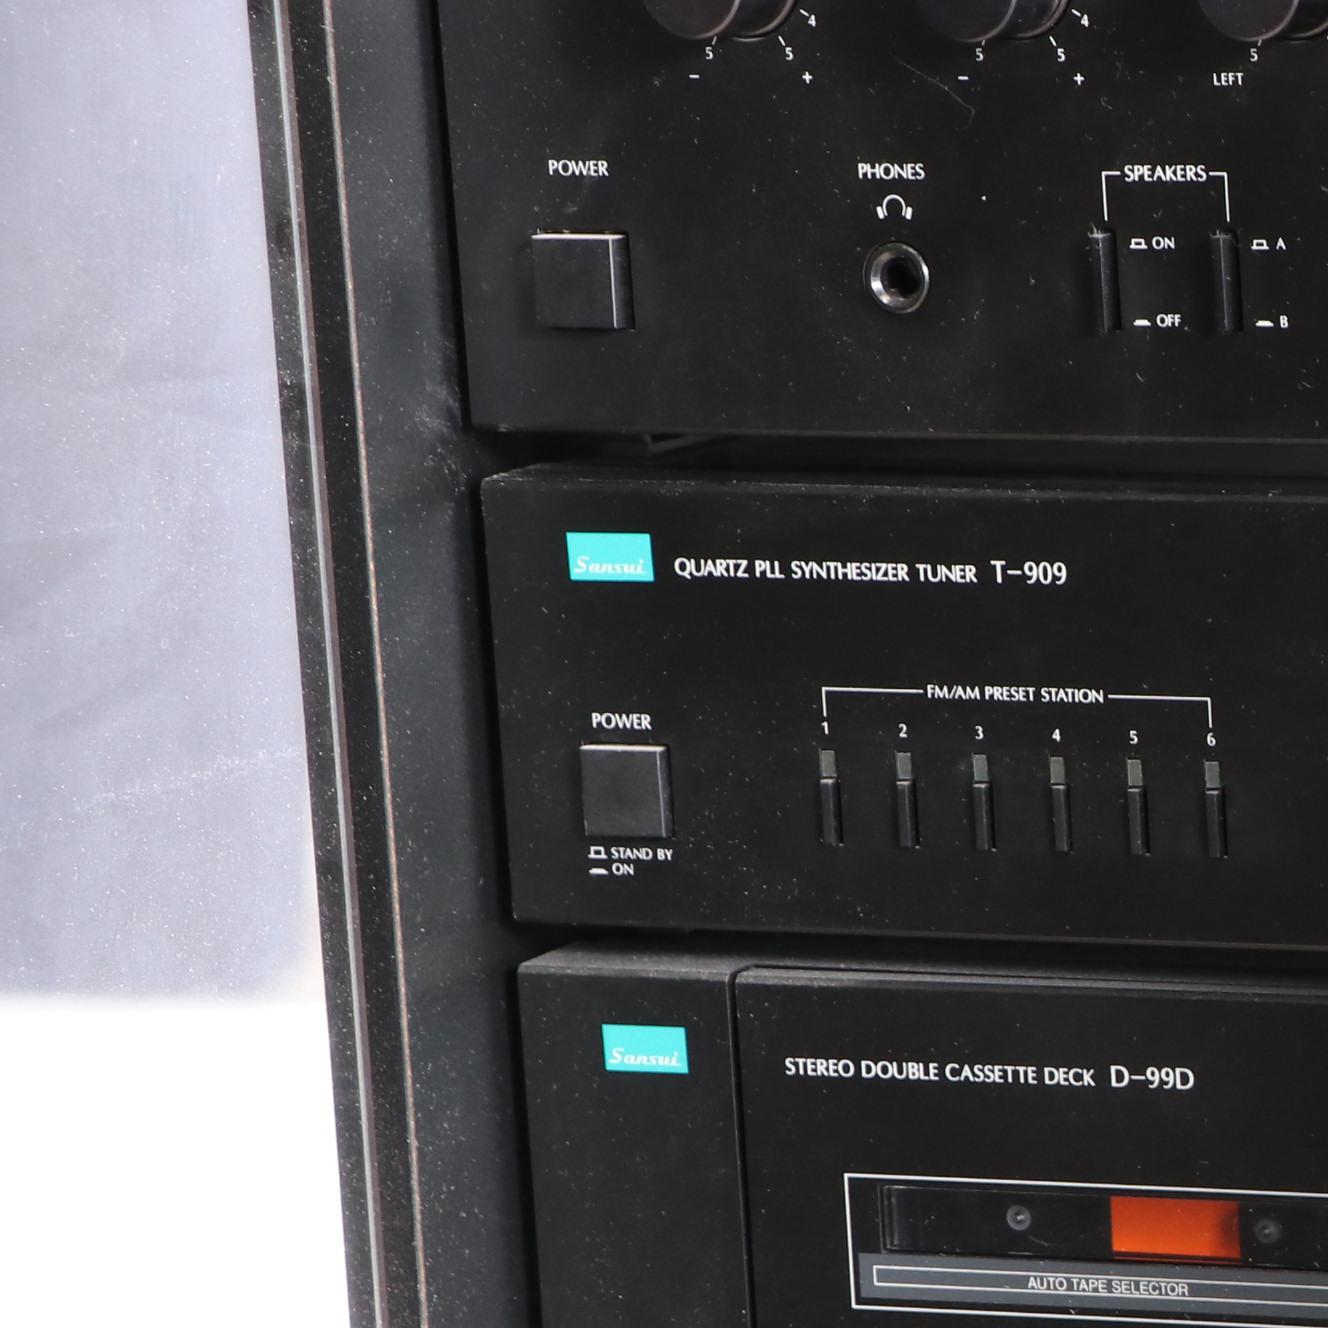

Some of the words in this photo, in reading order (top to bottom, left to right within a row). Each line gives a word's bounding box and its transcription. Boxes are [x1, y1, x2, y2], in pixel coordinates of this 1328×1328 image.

[1213, 72, 1243, 86] LEFT
[548, 159, 609, 177] POWER
[857, 162, 925, 180] PHONES
[1123, 165, 1207, 182] SPEAKERS
[574, 555, 647, 576] Sansui
[674, 557, 749, 578] QUARTZ
[754, 559, 785, 579] PLL
[791, 560, 909, 583] SYNTHESIZER
[916, 563, 977, 584] TUNER
[990, 560, 1068, 585] T-909
[926, 684, 982, 699] FM/AM
[985, 686, 1037, 701] PRESET
[1041, 688, 1105, 704] STATION
[591, 712, 652, 731] POWER
[610, 846, 653, 861] STAND
[658, 847, 673, 861] BY
[612, 862, 634, 876] ON
[609, 1046, 681, 1068] Sansui
[785, 1057, 855, 1080] STEREO
[860, 1059, 939, 1082] DOUBLE
[945, 1062, 1037, 1085] CASSETTE
[1042, 1065, 1096, 1088] DECK
[1109, 1064, 1195, 1091] D-99D
[1027, 1276, 1067, 1291] AUTO
[1071, 1278, 1108, 1293] TAPE
[1110, 1279, 1188, 1296] SELECTOR
